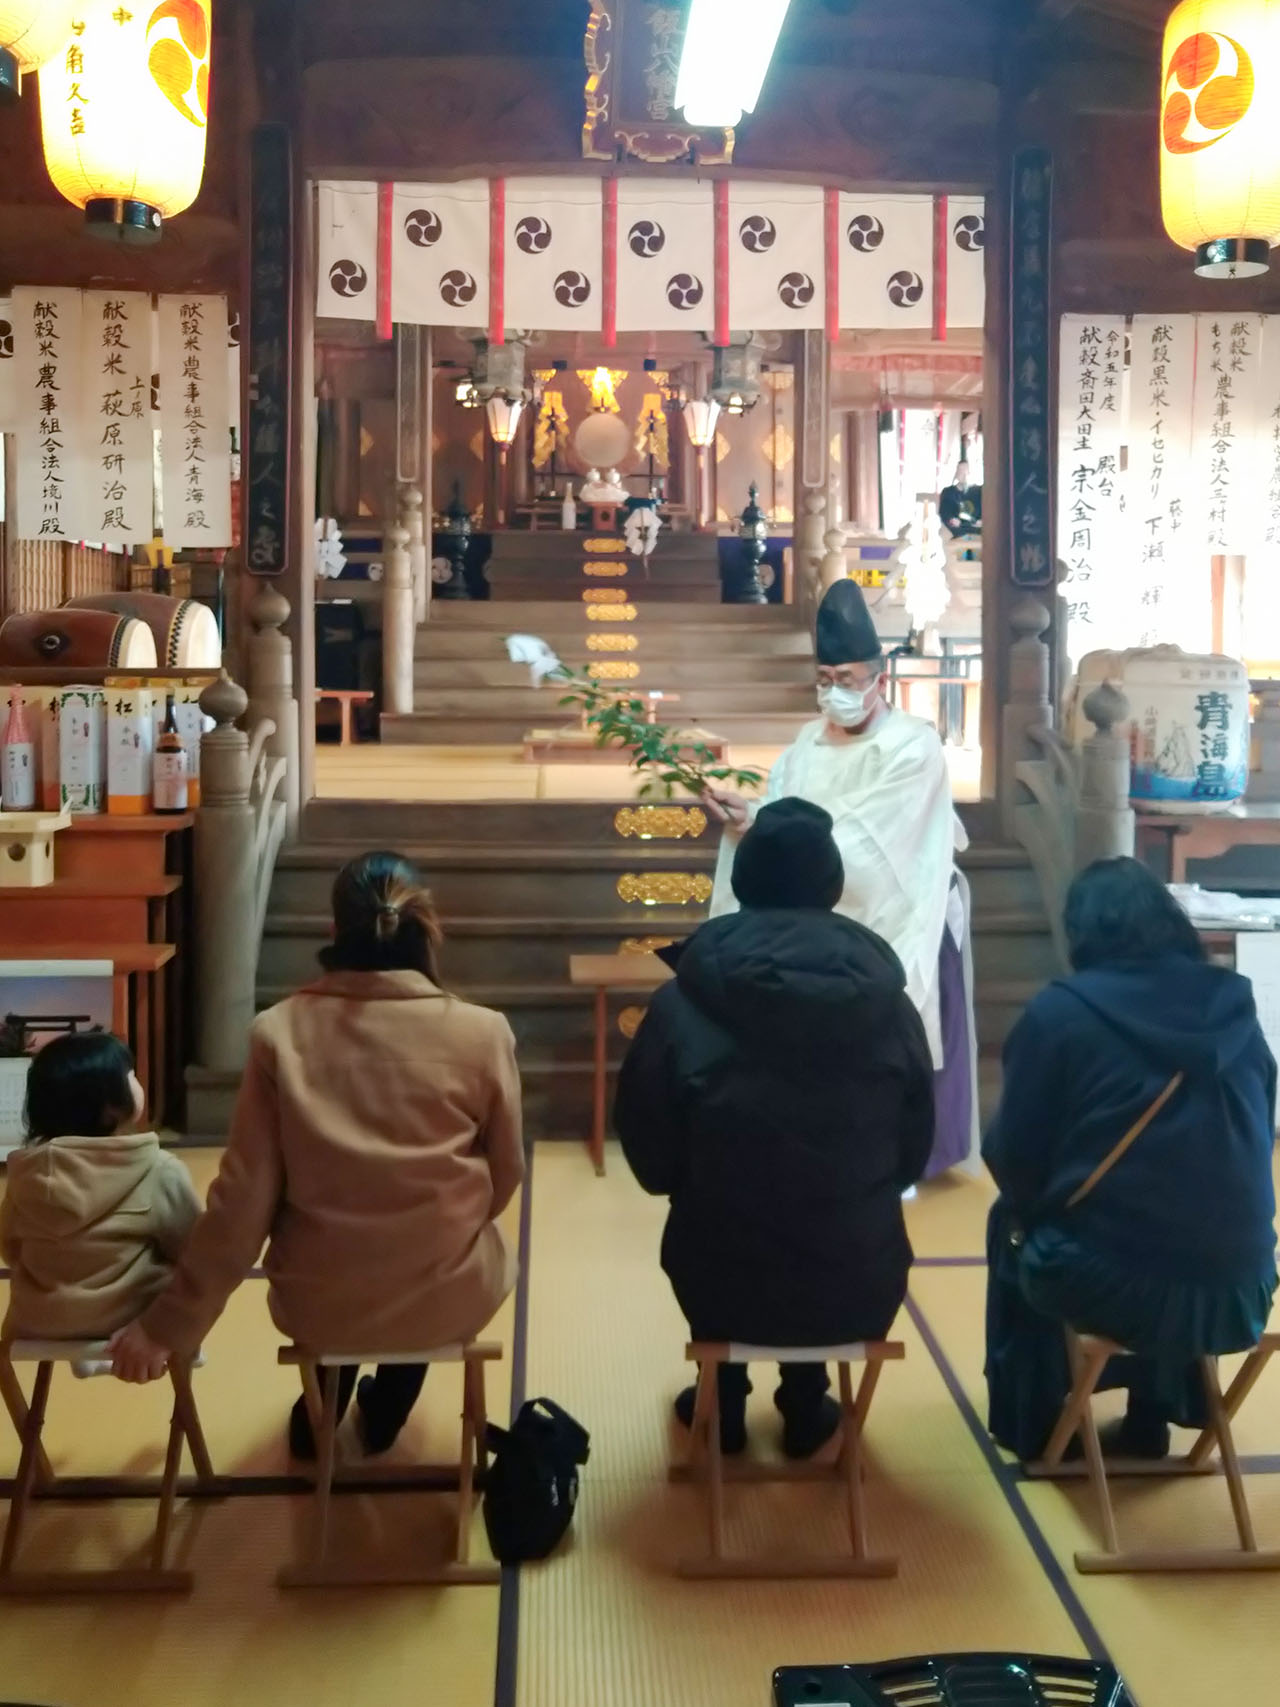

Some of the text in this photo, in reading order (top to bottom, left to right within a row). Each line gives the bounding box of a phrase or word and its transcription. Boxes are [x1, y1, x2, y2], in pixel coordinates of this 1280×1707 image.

[1099, 330, 1120, 412] 令和五年度
[1191, 691, 1232, 797] 青海島
